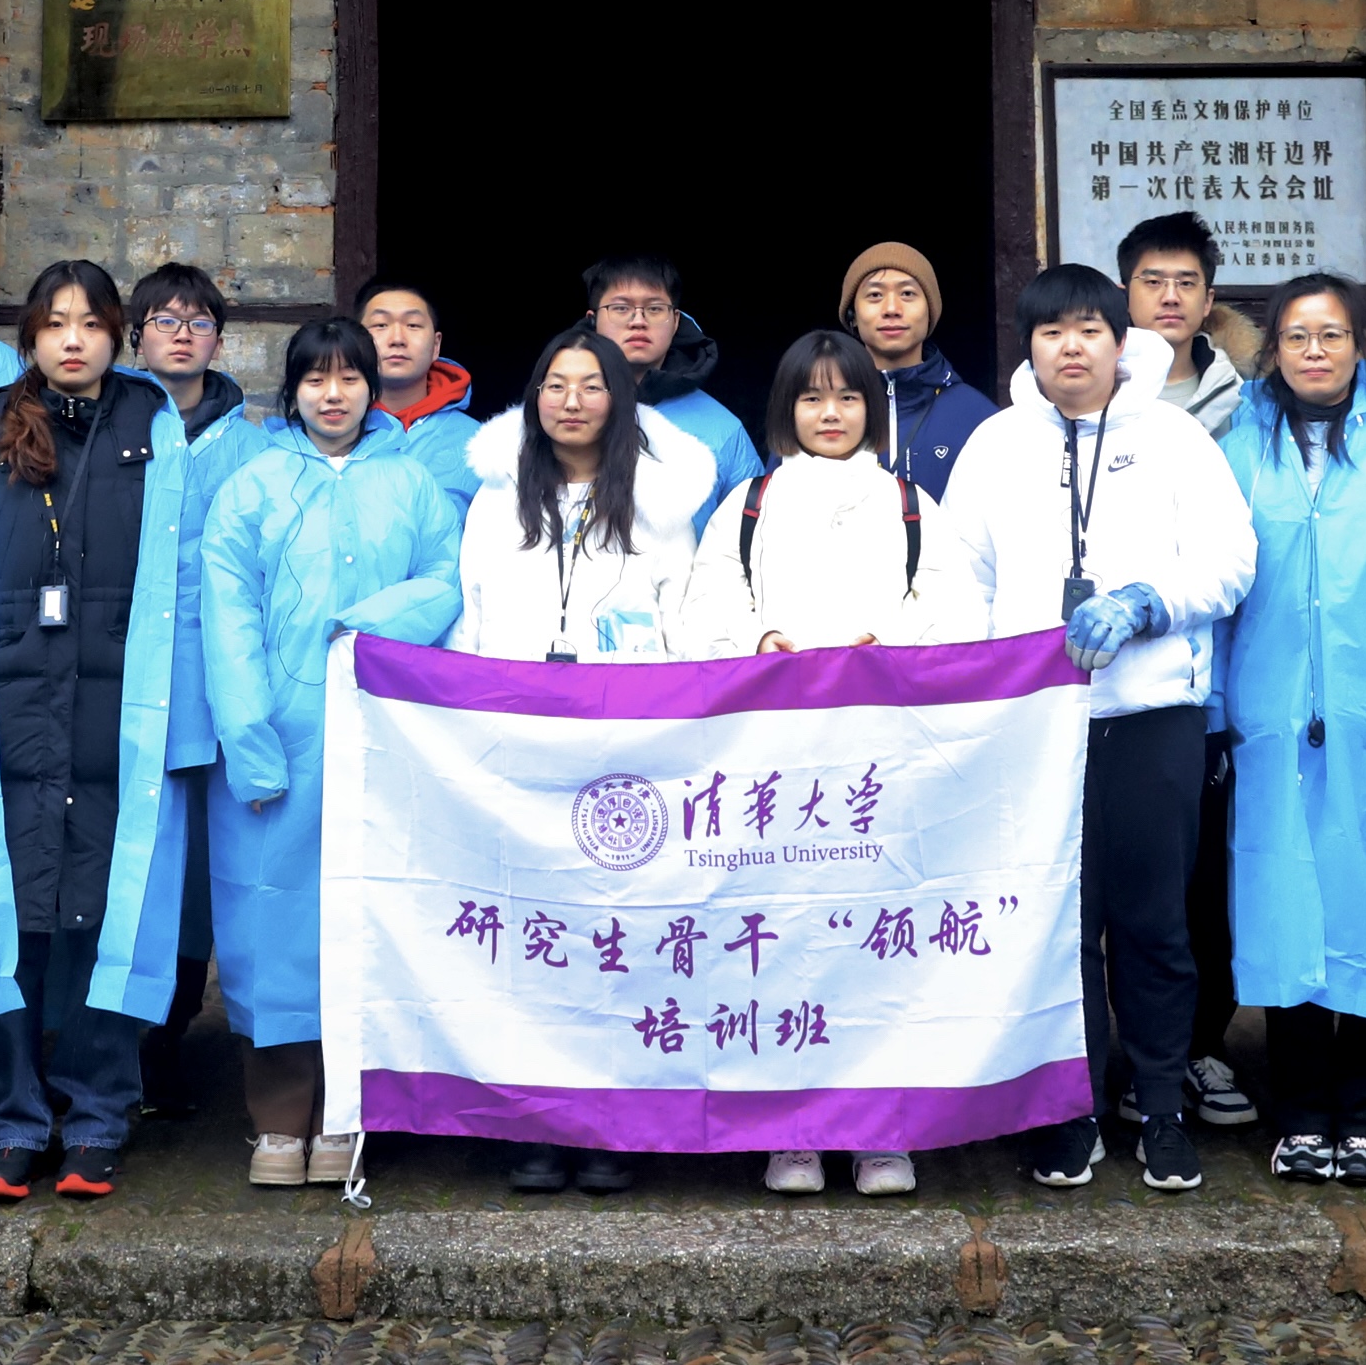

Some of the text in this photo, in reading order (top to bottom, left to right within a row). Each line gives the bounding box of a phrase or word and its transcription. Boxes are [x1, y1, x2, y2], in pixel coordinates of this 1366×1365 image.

[1108, 99, 1314, 121] 全国重点文物保护单位
[1091, 175, 1335, 201] 第一次代表大会会址
[1112, 453, 1137, 465] NIKE
[684, 840, 884, 872] Tsinghua University
[633, 997, 830, 1054] 培训班
